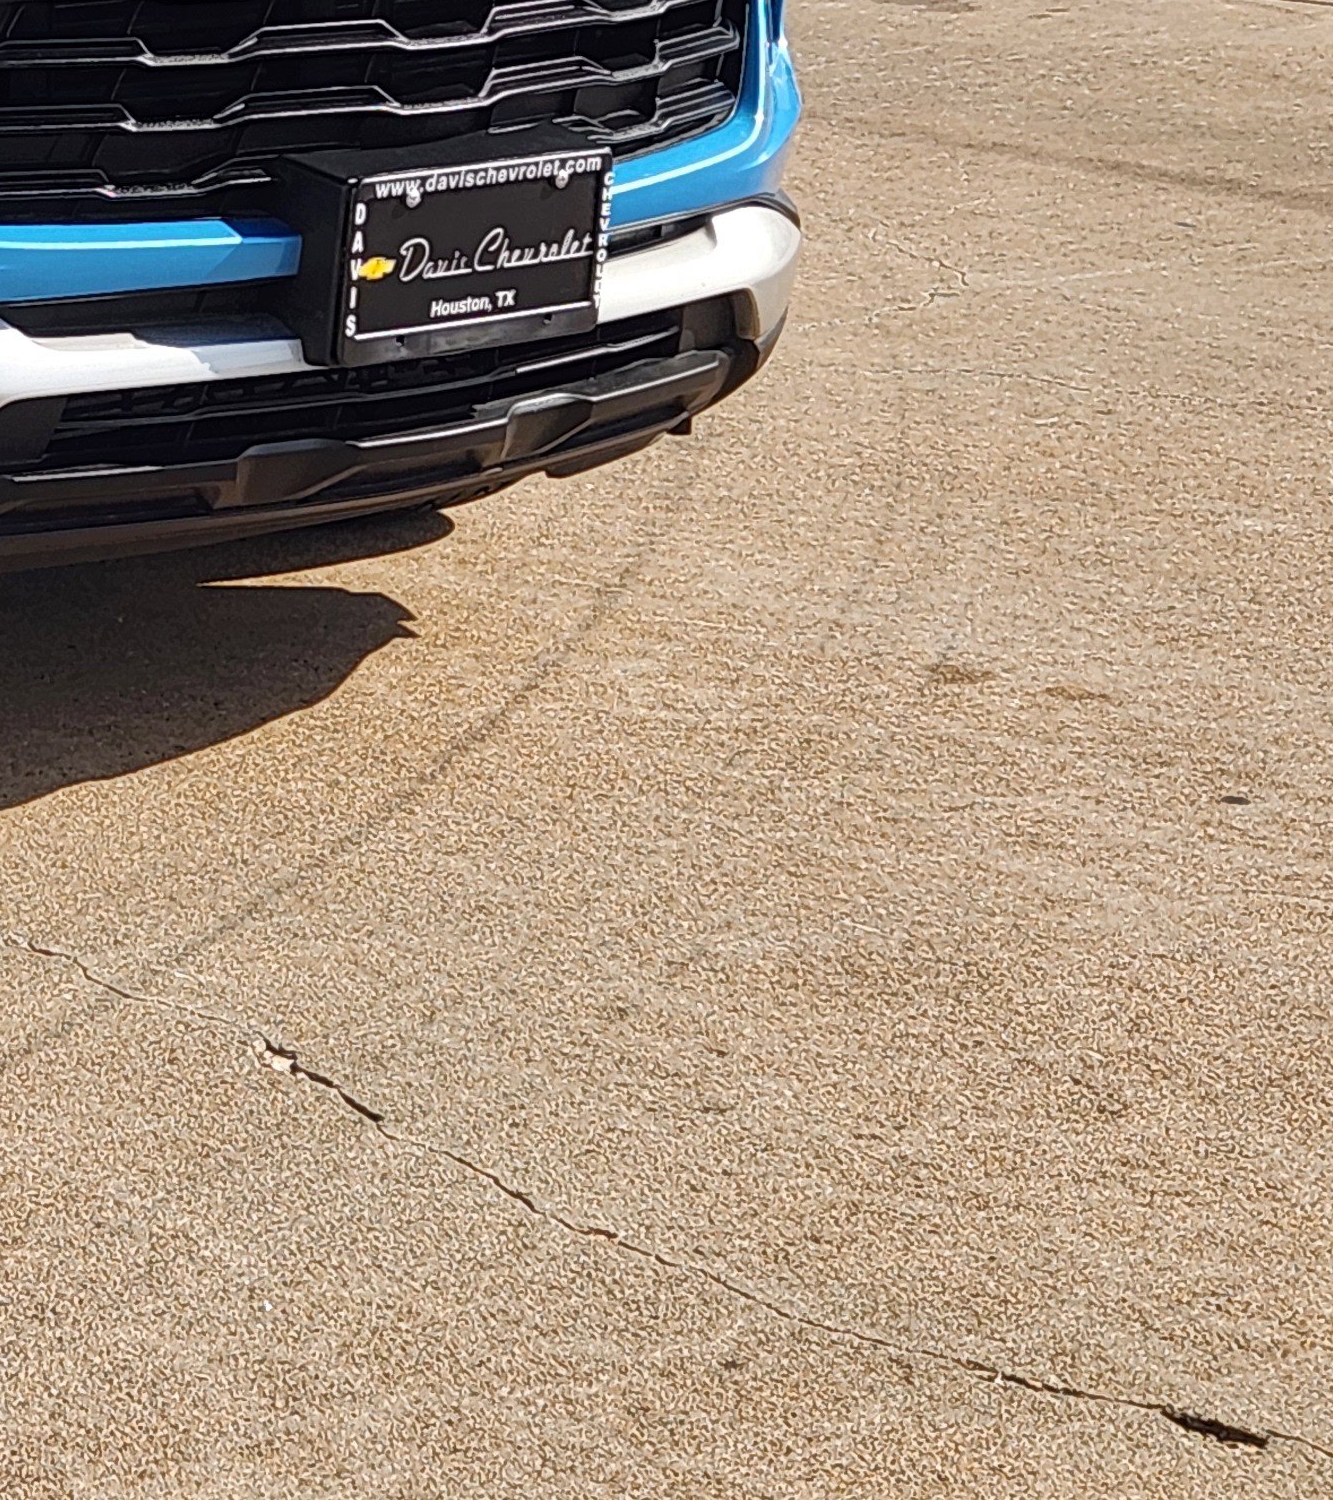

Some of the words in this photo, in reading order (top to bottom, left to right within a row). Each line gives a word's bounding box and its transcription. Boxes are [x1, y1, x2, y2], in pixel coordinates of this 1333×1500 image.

[374, 156, 603, 198] www.davischevrolet.com
[345, 202, 368, 338] DAVIS
[473, 227, 594, 272] Chevrolet
[430, 295, 493, 318] Houston,
[495, 289, 517, 308] TX
